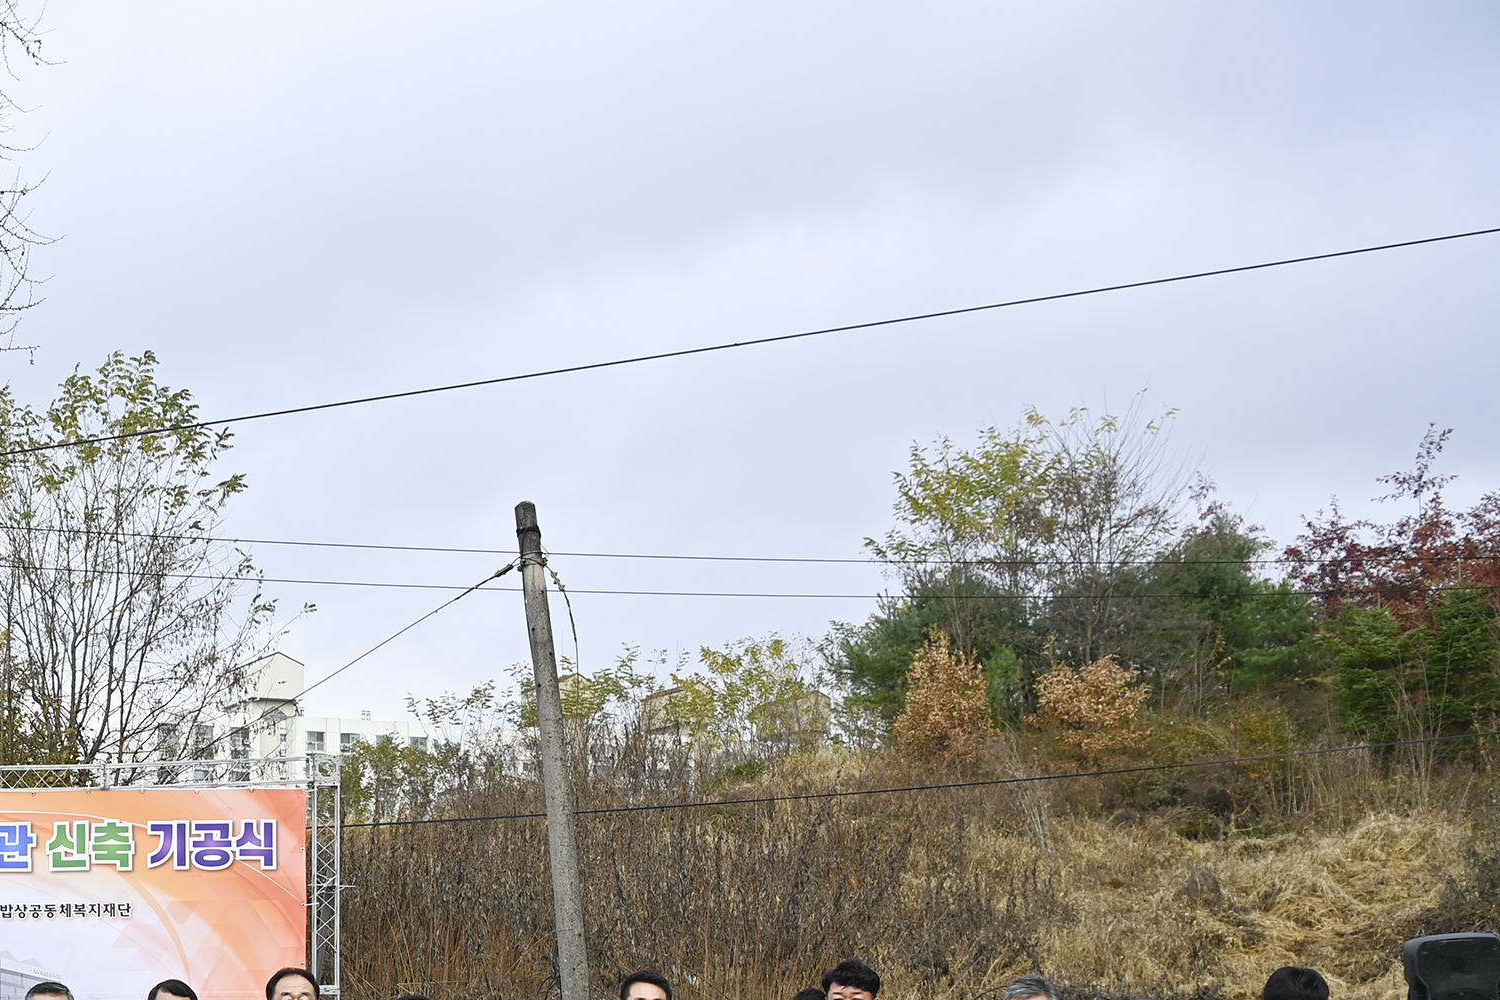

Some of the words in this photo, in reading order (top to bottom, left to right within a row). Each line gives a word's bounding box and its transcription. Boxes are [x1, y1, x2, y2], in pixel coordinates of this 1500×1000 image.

[48, 820, 134, 872] 신축
[148, 819, 277, 870] 기공식
[0, 903, 132, 919] 밥상공동체복지재단
